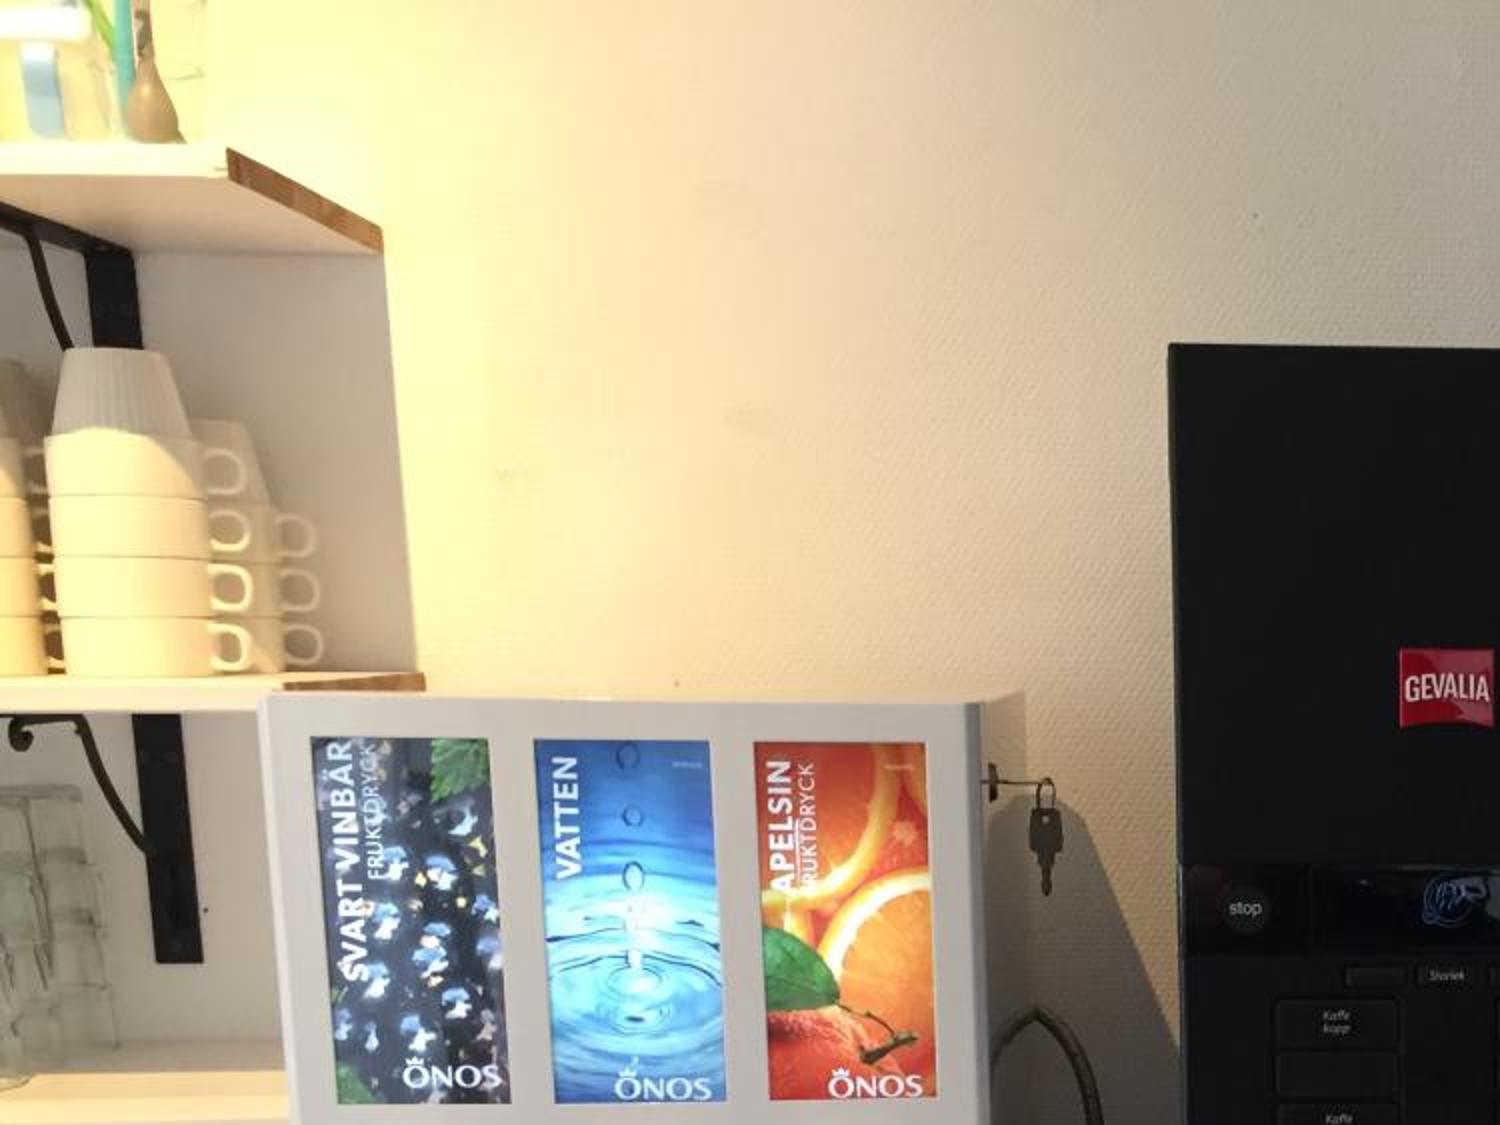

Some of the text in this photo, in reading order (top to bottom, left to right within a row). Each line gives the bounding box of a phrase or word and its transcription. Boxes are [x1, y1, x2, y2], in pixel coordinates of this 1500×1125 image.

[1404, 671, 1491, 703] GEVALIA
[321, 741, 369, 983] SVART VINBÄR
[551, 755, 583, 880] VATTEN
[765, 760, 796, 893] APELSIN
[797, 762, 818, 888] RUKTDRYCK
[1229, 901, 1263, 919] stop
